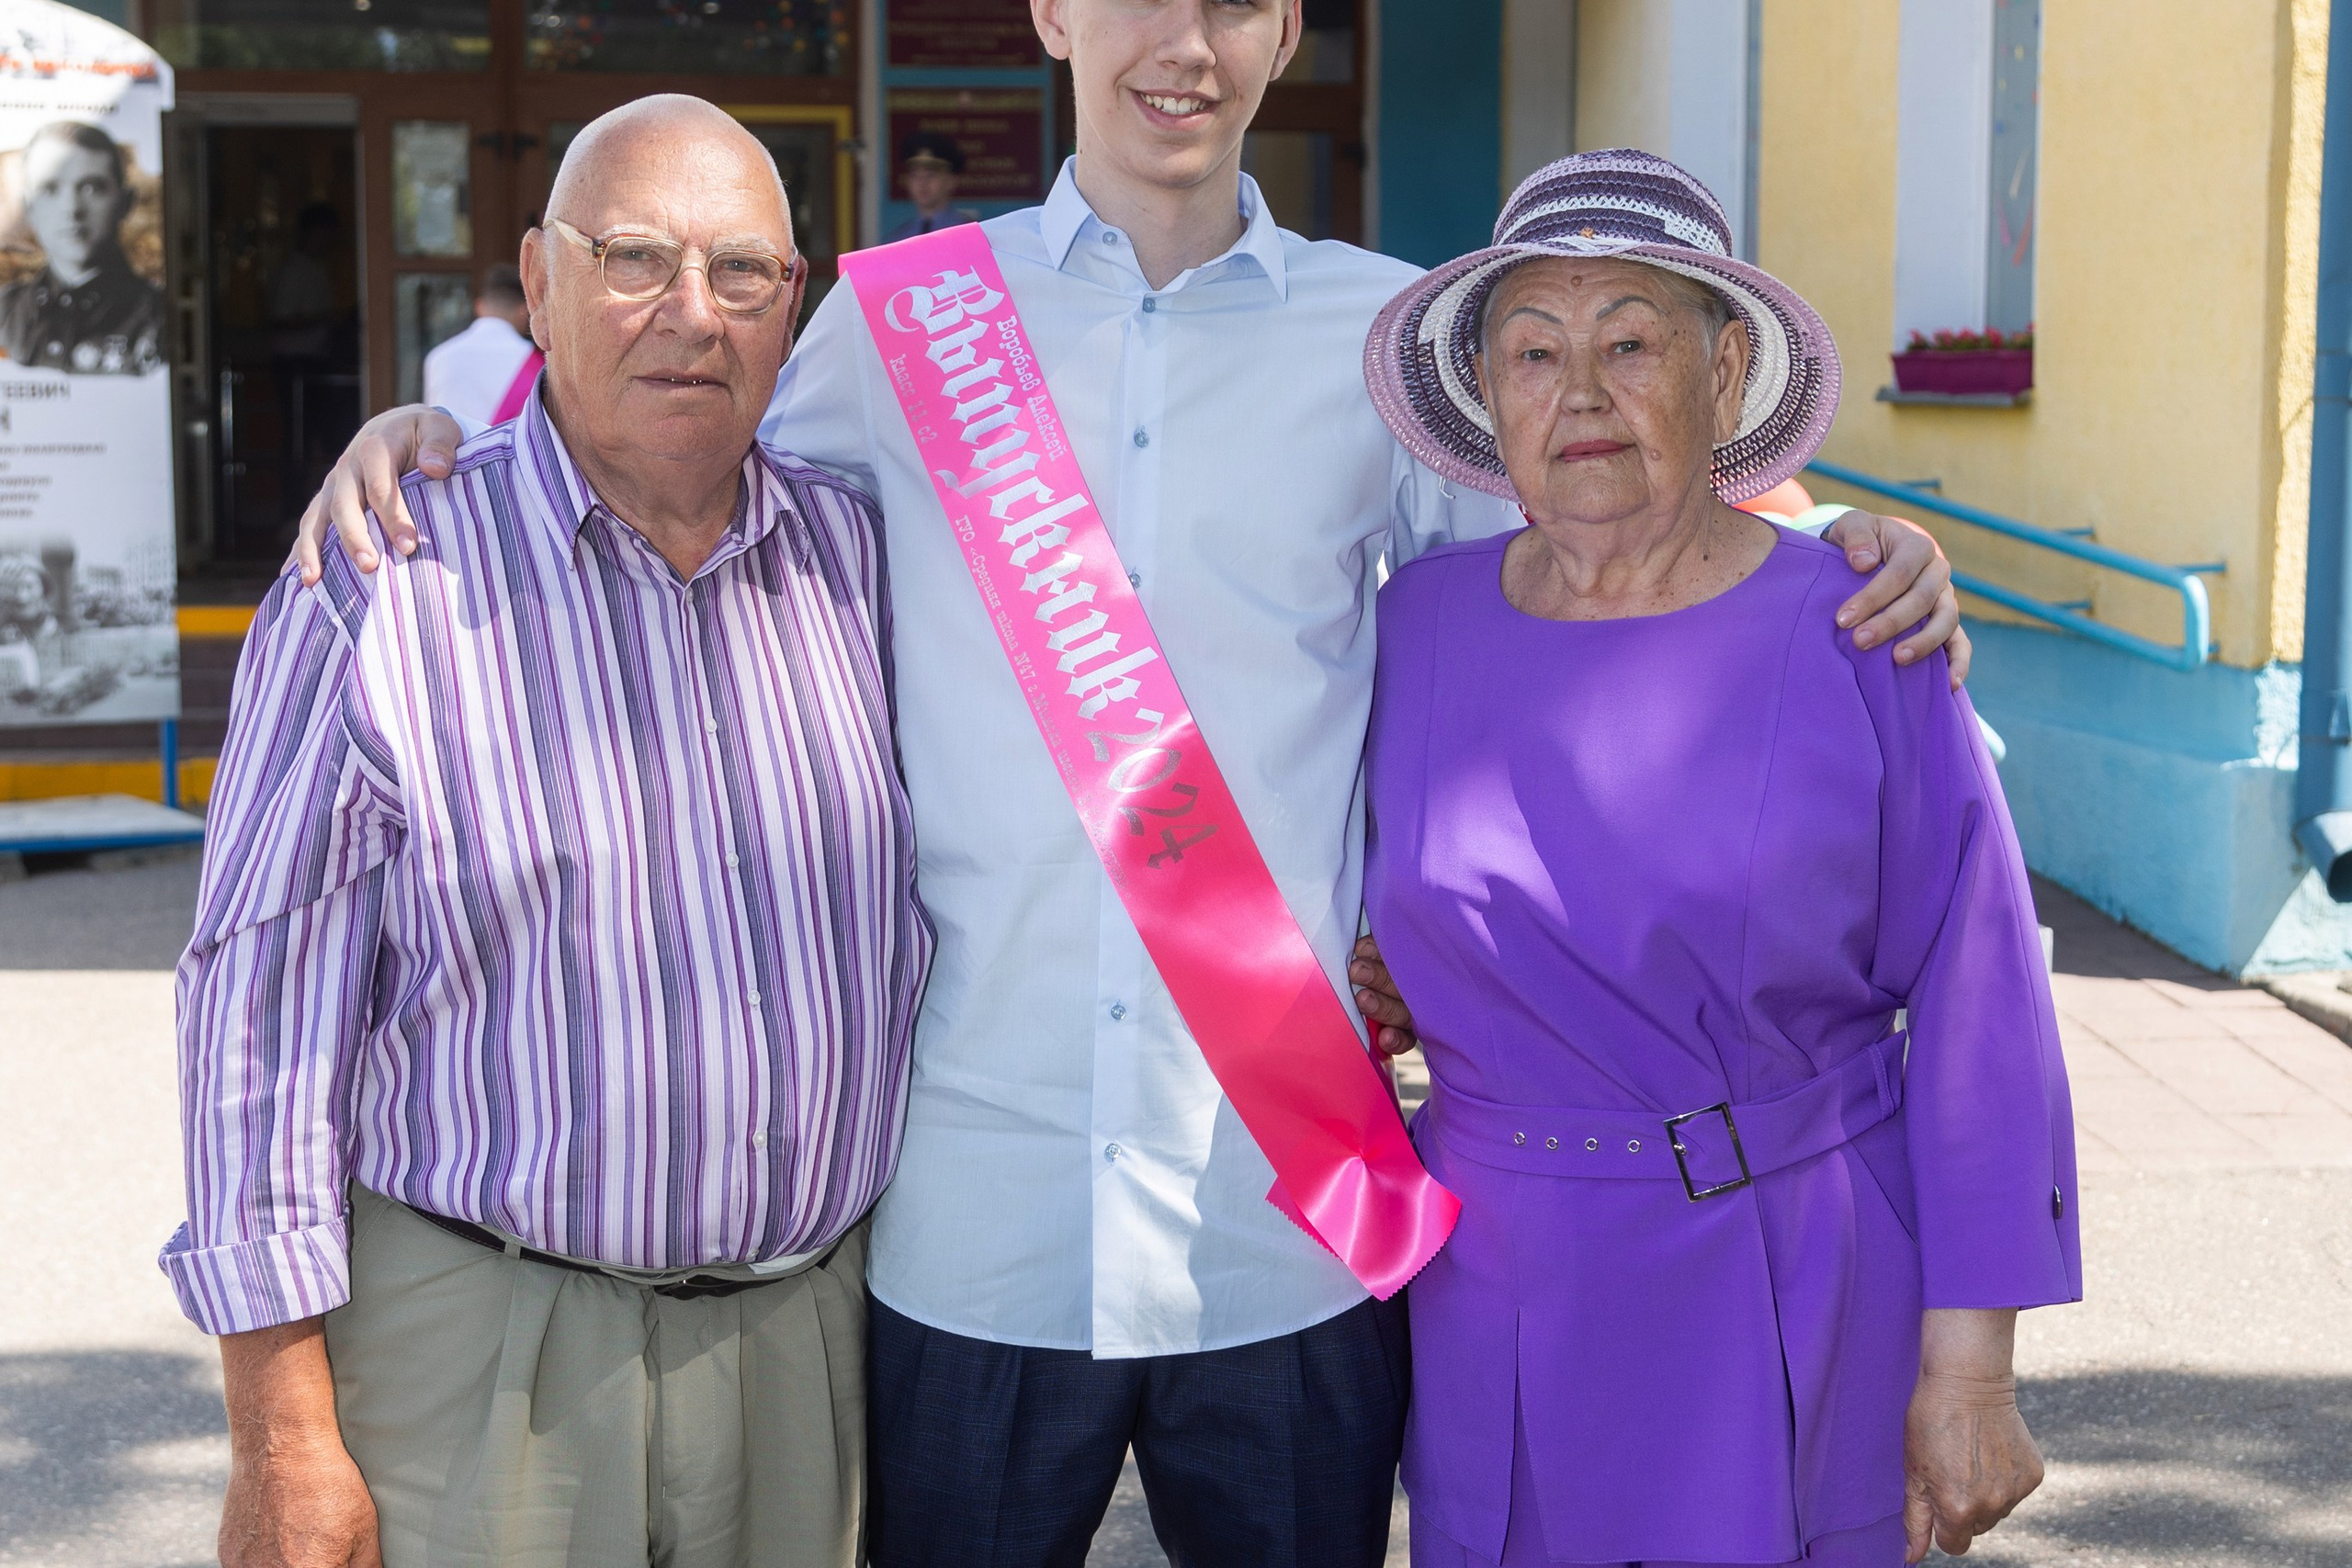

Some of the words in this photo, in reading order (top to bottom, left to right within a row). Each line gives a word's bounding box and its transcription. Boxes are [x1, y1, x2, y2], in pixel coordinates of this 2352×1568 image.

[889, 353, 917, 398] класс
[997, 315, 1041, 391] Воробьев
[1027, 394, 1067, 461] Алексей
[885, 265, 1159, 720] Выпускник
[1085, 706, 1219, 870] 2024
[955, 514, 976, 543] ГУО
[996, 611, 1020, 651] школа
